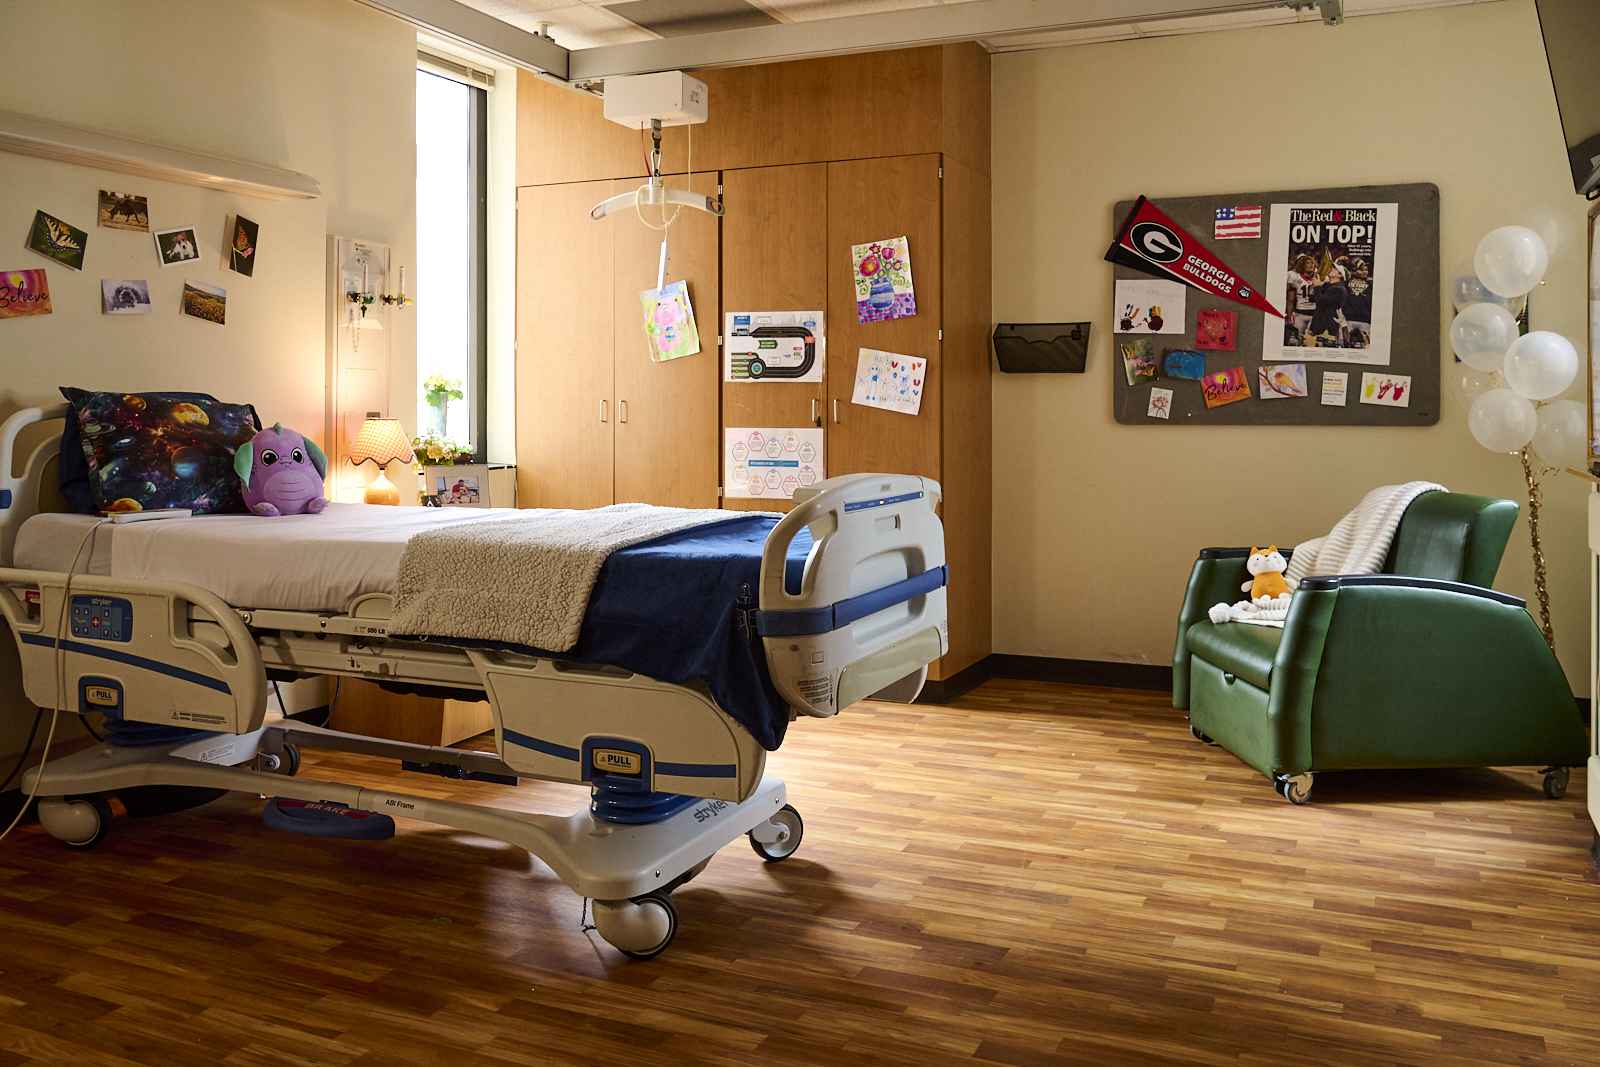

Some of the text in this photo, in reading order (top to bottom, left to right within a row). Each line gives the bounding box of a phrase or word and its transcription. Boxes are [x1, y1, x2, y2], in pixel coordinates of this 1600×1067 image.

[1291, 209, 1312, 222] The
[1312, 209, 1333, 222] Red
[1345, 209, 1376, 222] Black
[1291, 224, 1374, 244] ON TOP!
[1182, 263, 1232, 293] BULLDOGS
[1187, 254, 1235, 286] GEORGIA
[1204, 378, 1245, 401] Believe
[96, 690, 112, 699] PULL
[607, 754, 632, 765] PULL
